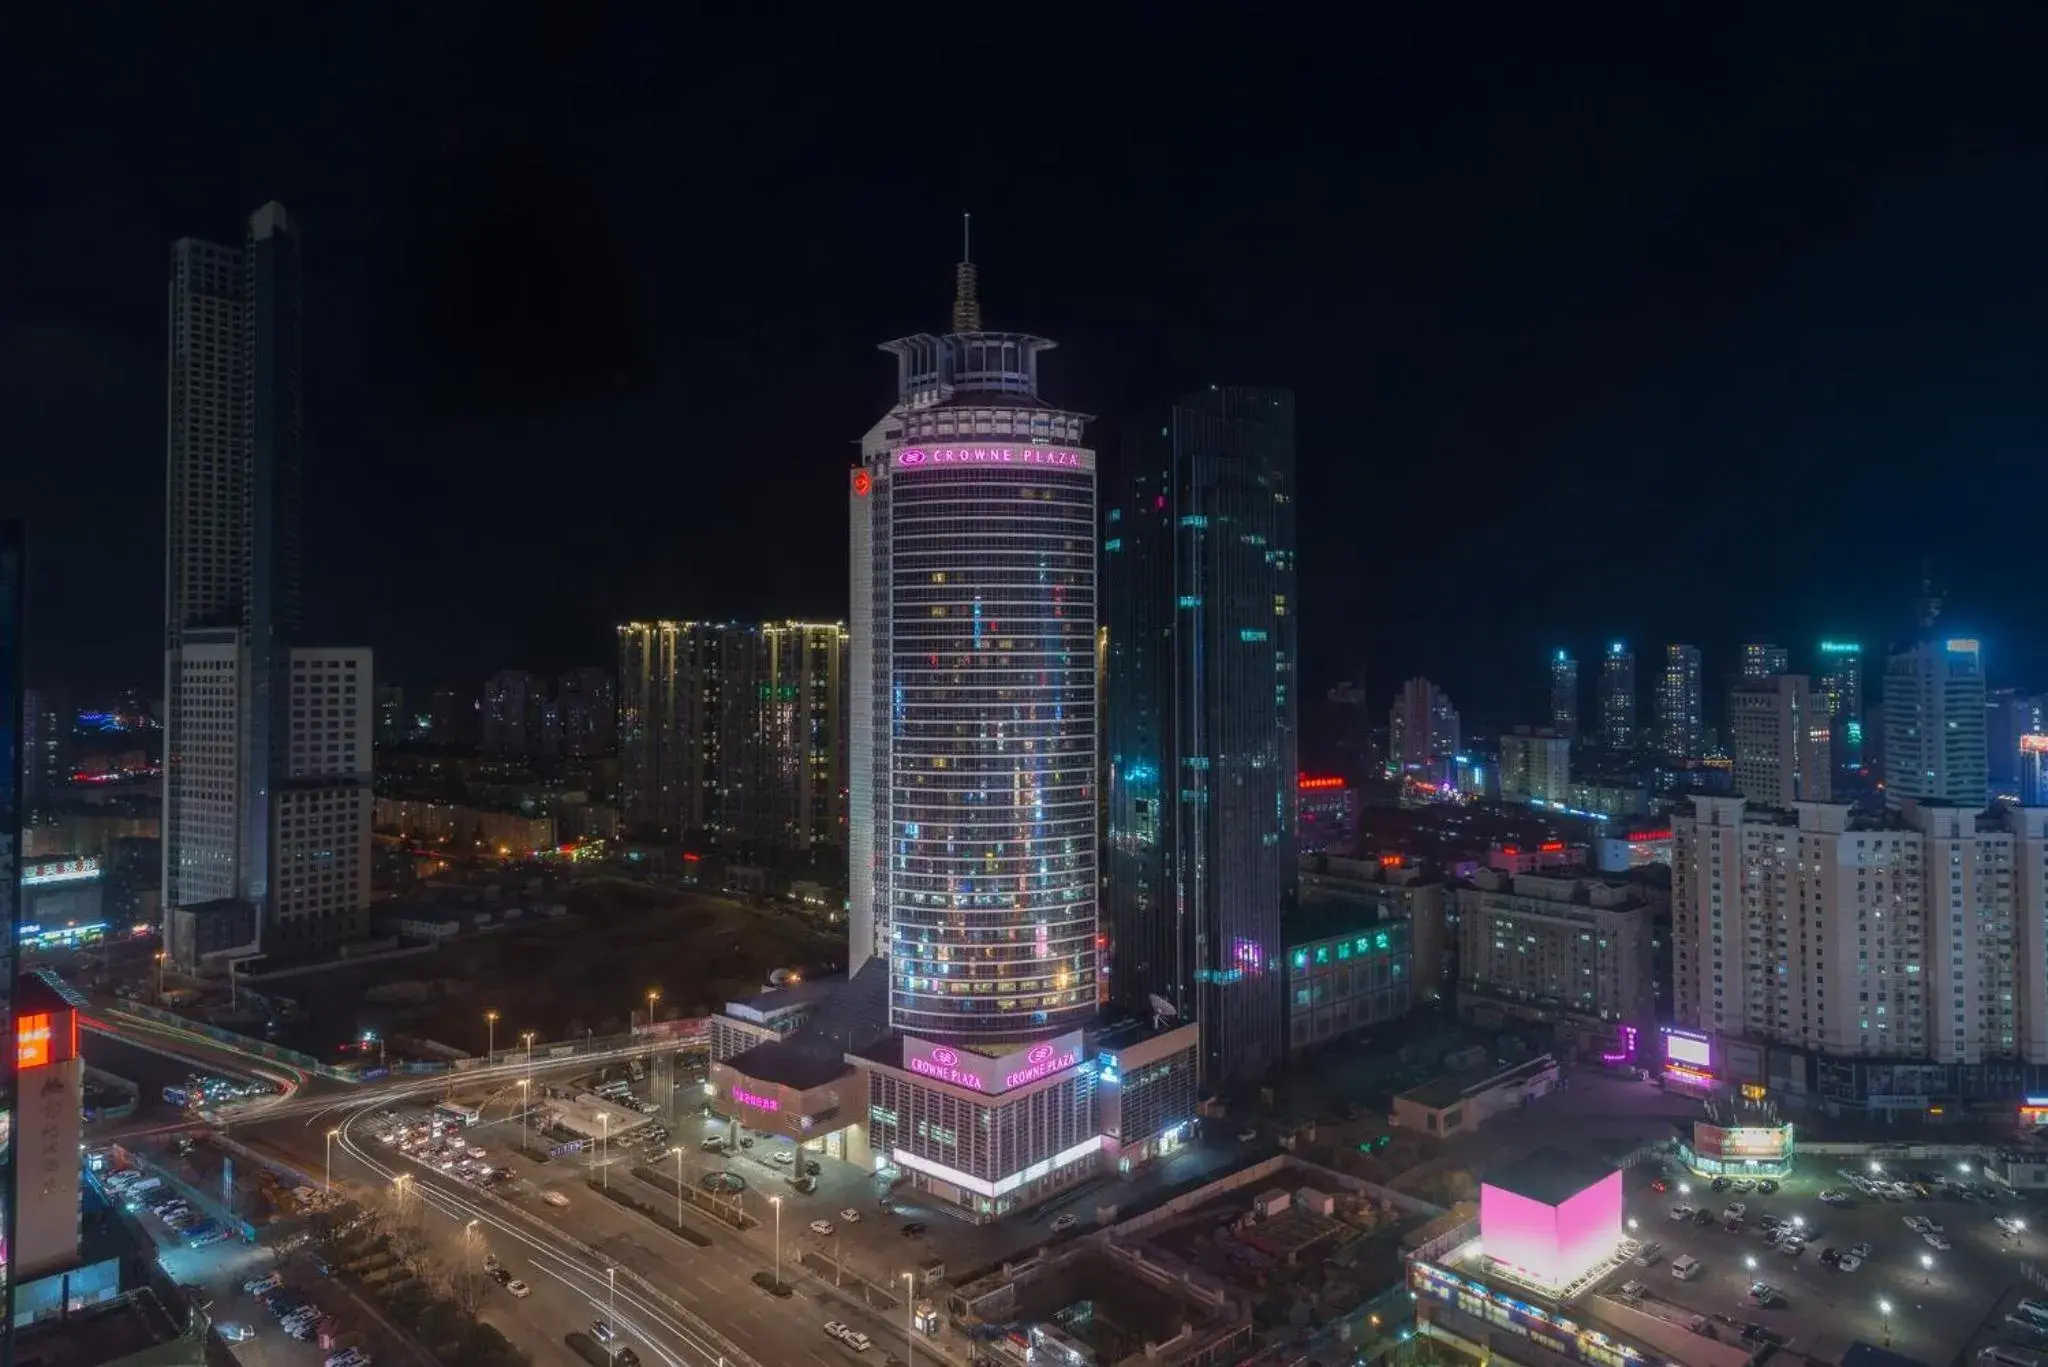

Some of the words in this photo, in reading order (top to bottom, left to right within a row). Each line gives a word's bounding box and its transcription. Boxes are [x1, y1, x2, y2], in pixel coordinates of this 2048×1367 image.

[934, 448, 1010, 462] CROWNE
[1024, 449, 1077, 465] PLAZA
[912, 1058, 948, 1080] CROWNE
[951, 1069, 981, 1089] PLAZA
[1007, 1063, 1045, 1087] CROWNE
[1047, 1053, 1075, 1072] PLAZA
